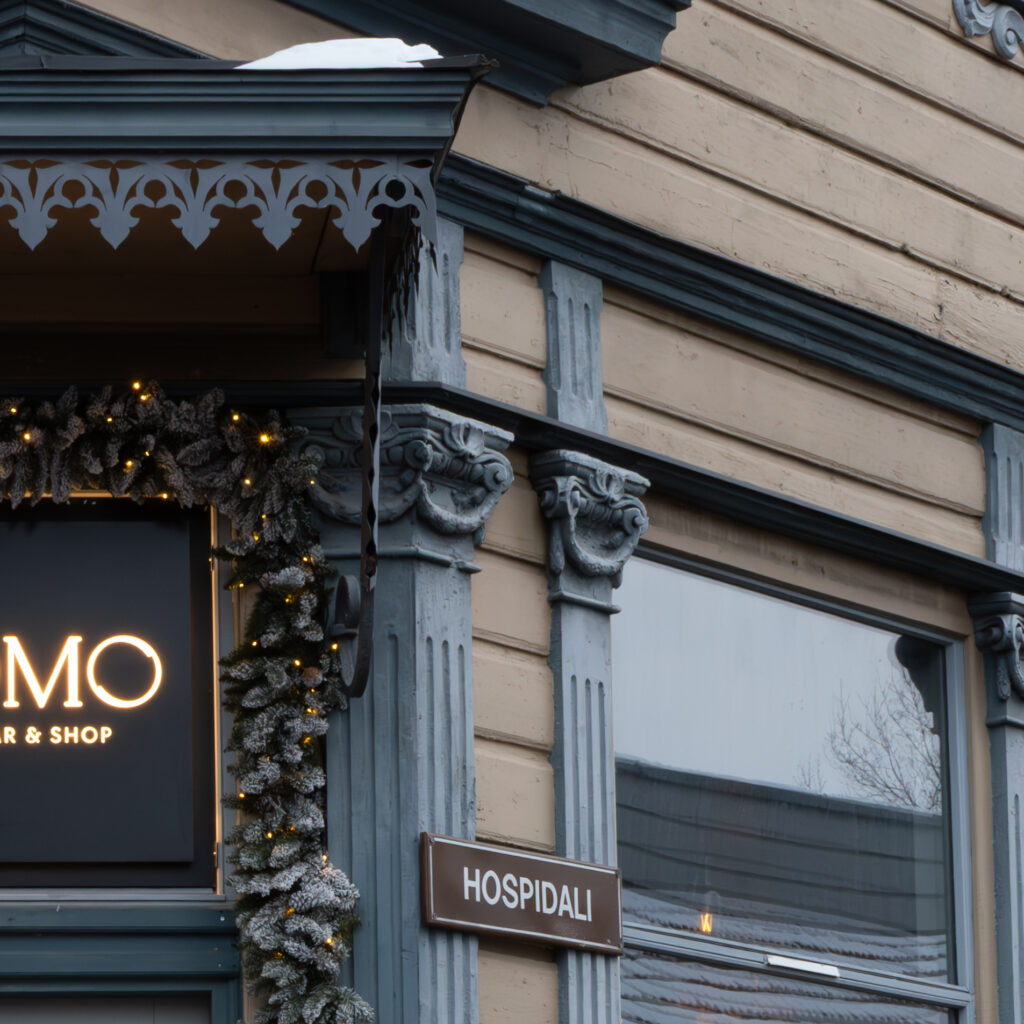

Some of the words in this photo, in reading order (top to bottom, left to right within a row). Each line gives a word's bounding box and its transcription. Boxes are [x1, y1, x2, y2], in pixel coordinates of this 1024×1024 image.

[25, 726, 42, 744] &
[49, 726, 113, 744] SHOP
[462, 866, 592, 922] HOSPIDALI
